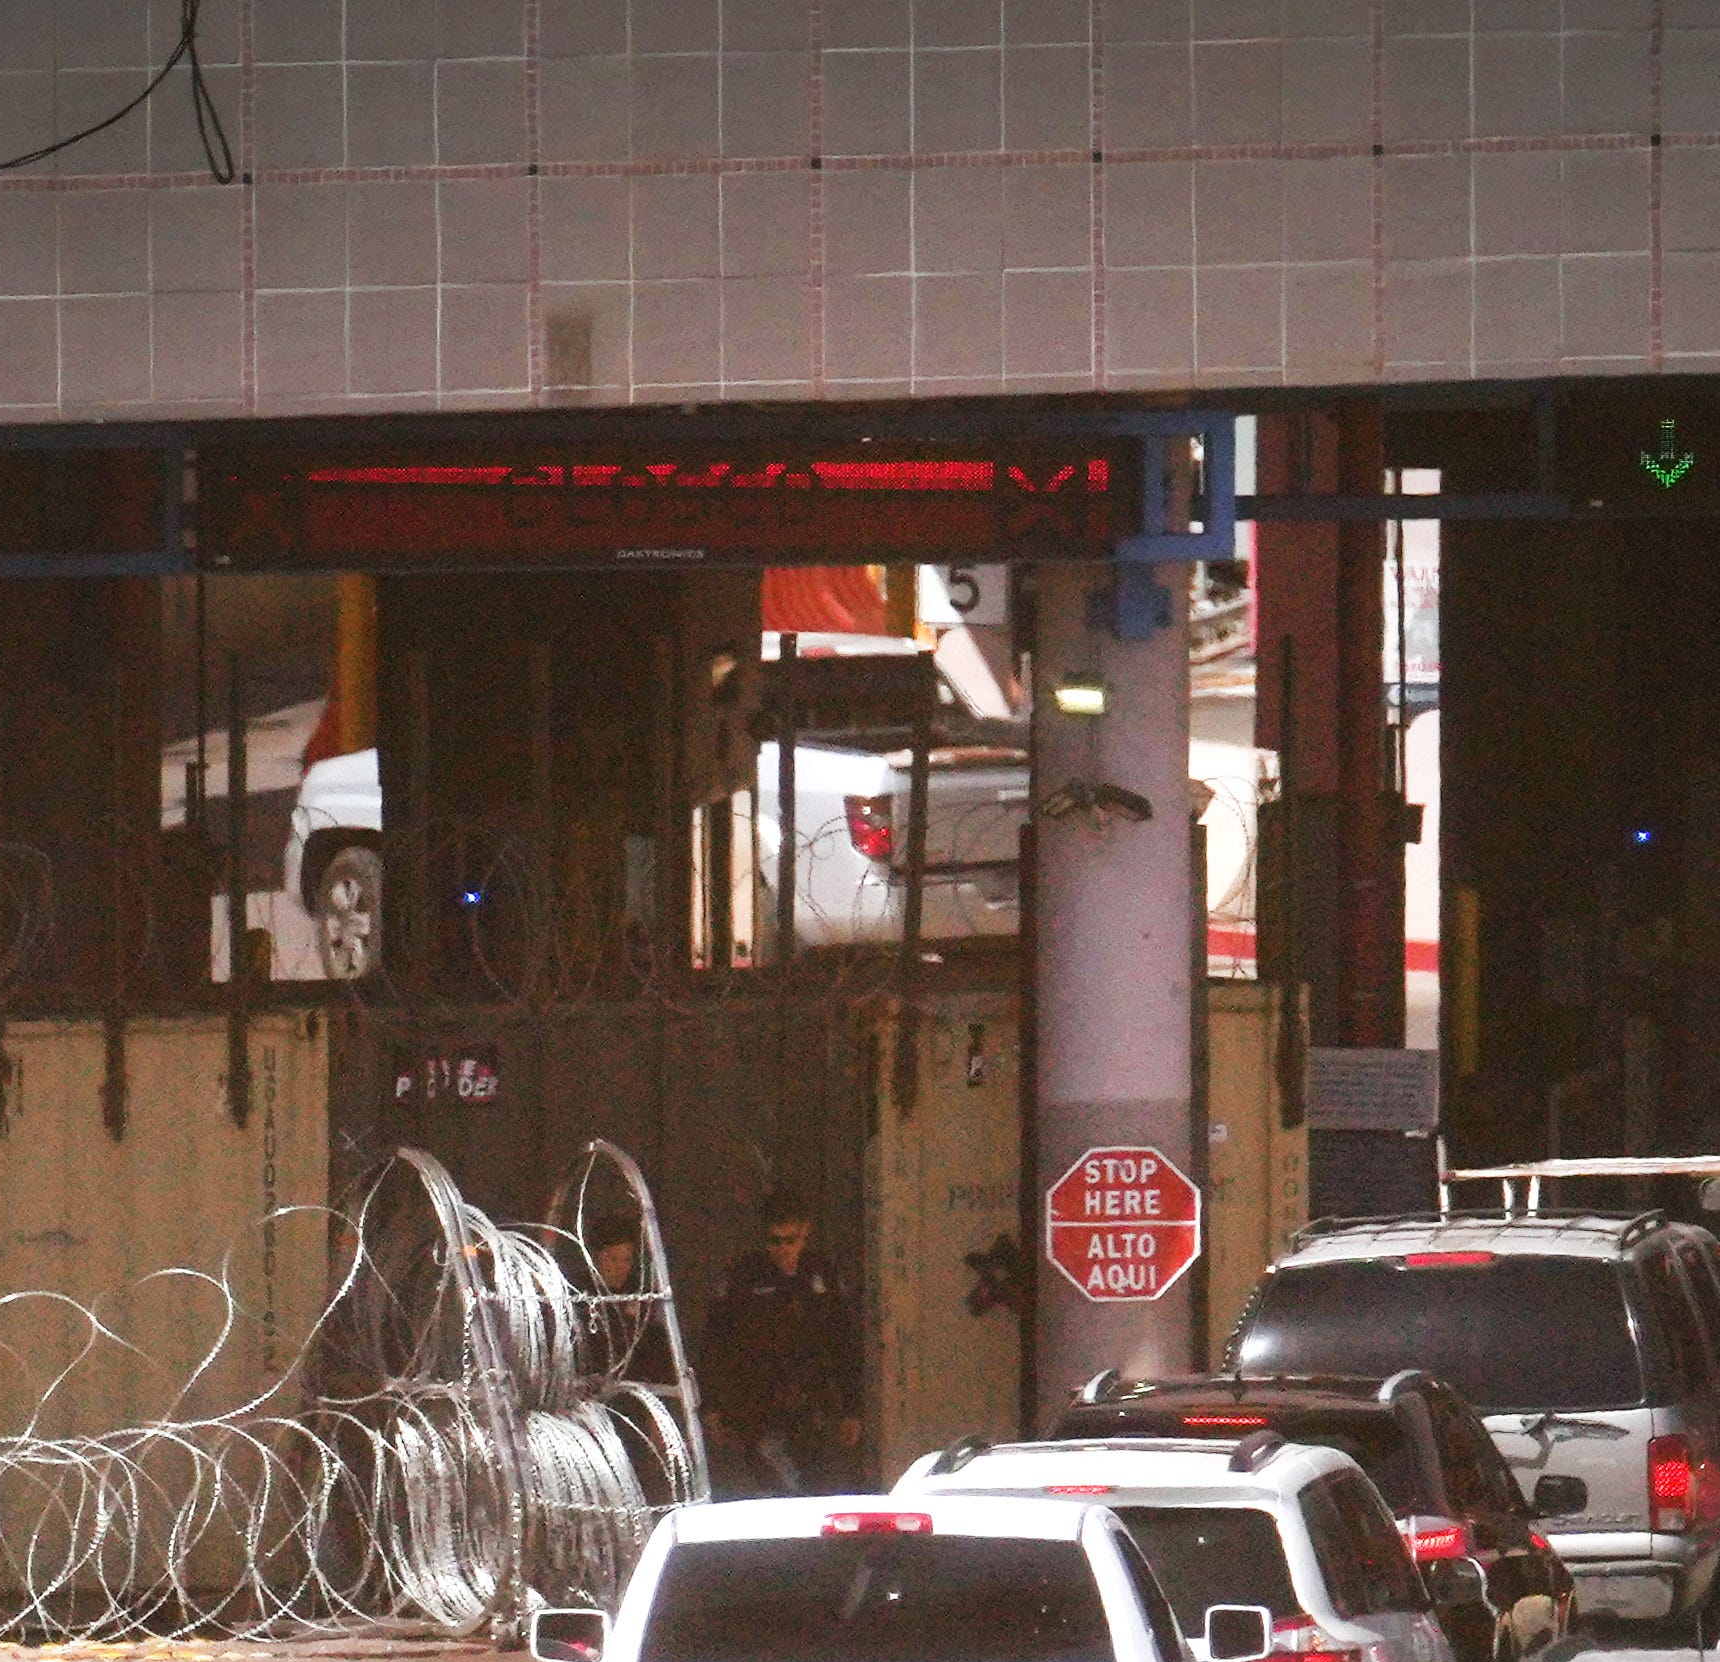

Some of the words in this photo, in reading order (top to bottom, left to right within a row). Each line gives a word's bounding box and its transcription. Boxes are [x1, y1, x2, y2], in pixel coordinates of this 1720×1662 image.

[949, 562, 980, 613] 5
[1084, 1158, 1158, 1184] STOP
[1084, 1189, 1161, 1216] HERE
[1087, 1233, 1156, 1259] ALTO
[1087, 1264, 1157, 1294] AQUI
